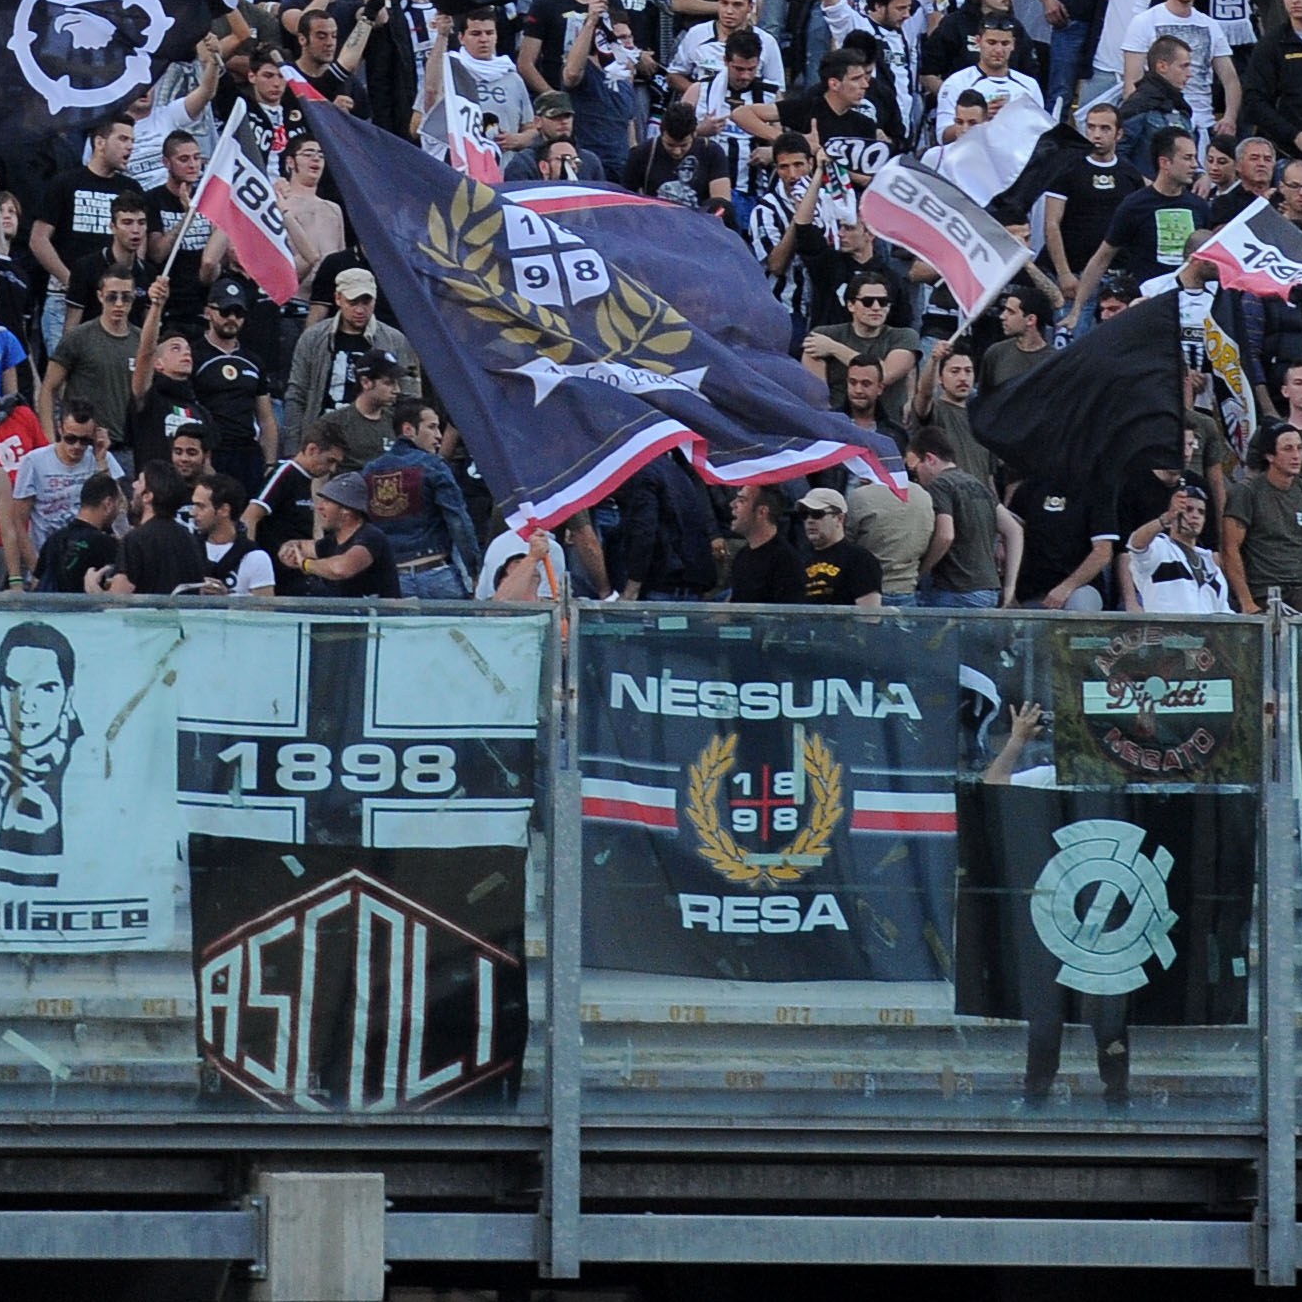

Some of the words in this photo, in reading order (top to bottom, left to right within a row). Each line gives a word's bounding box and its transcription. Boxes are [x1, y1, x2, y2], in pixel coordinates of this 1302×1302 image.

[231, 157, 288, 249] 189
[609, 671, 924, 721] NESSUNA
[216, 740, 458, 795] 1898
[678, 892, 850, 934] RESA
[201, 889, 495, 1112] ASCOLI
